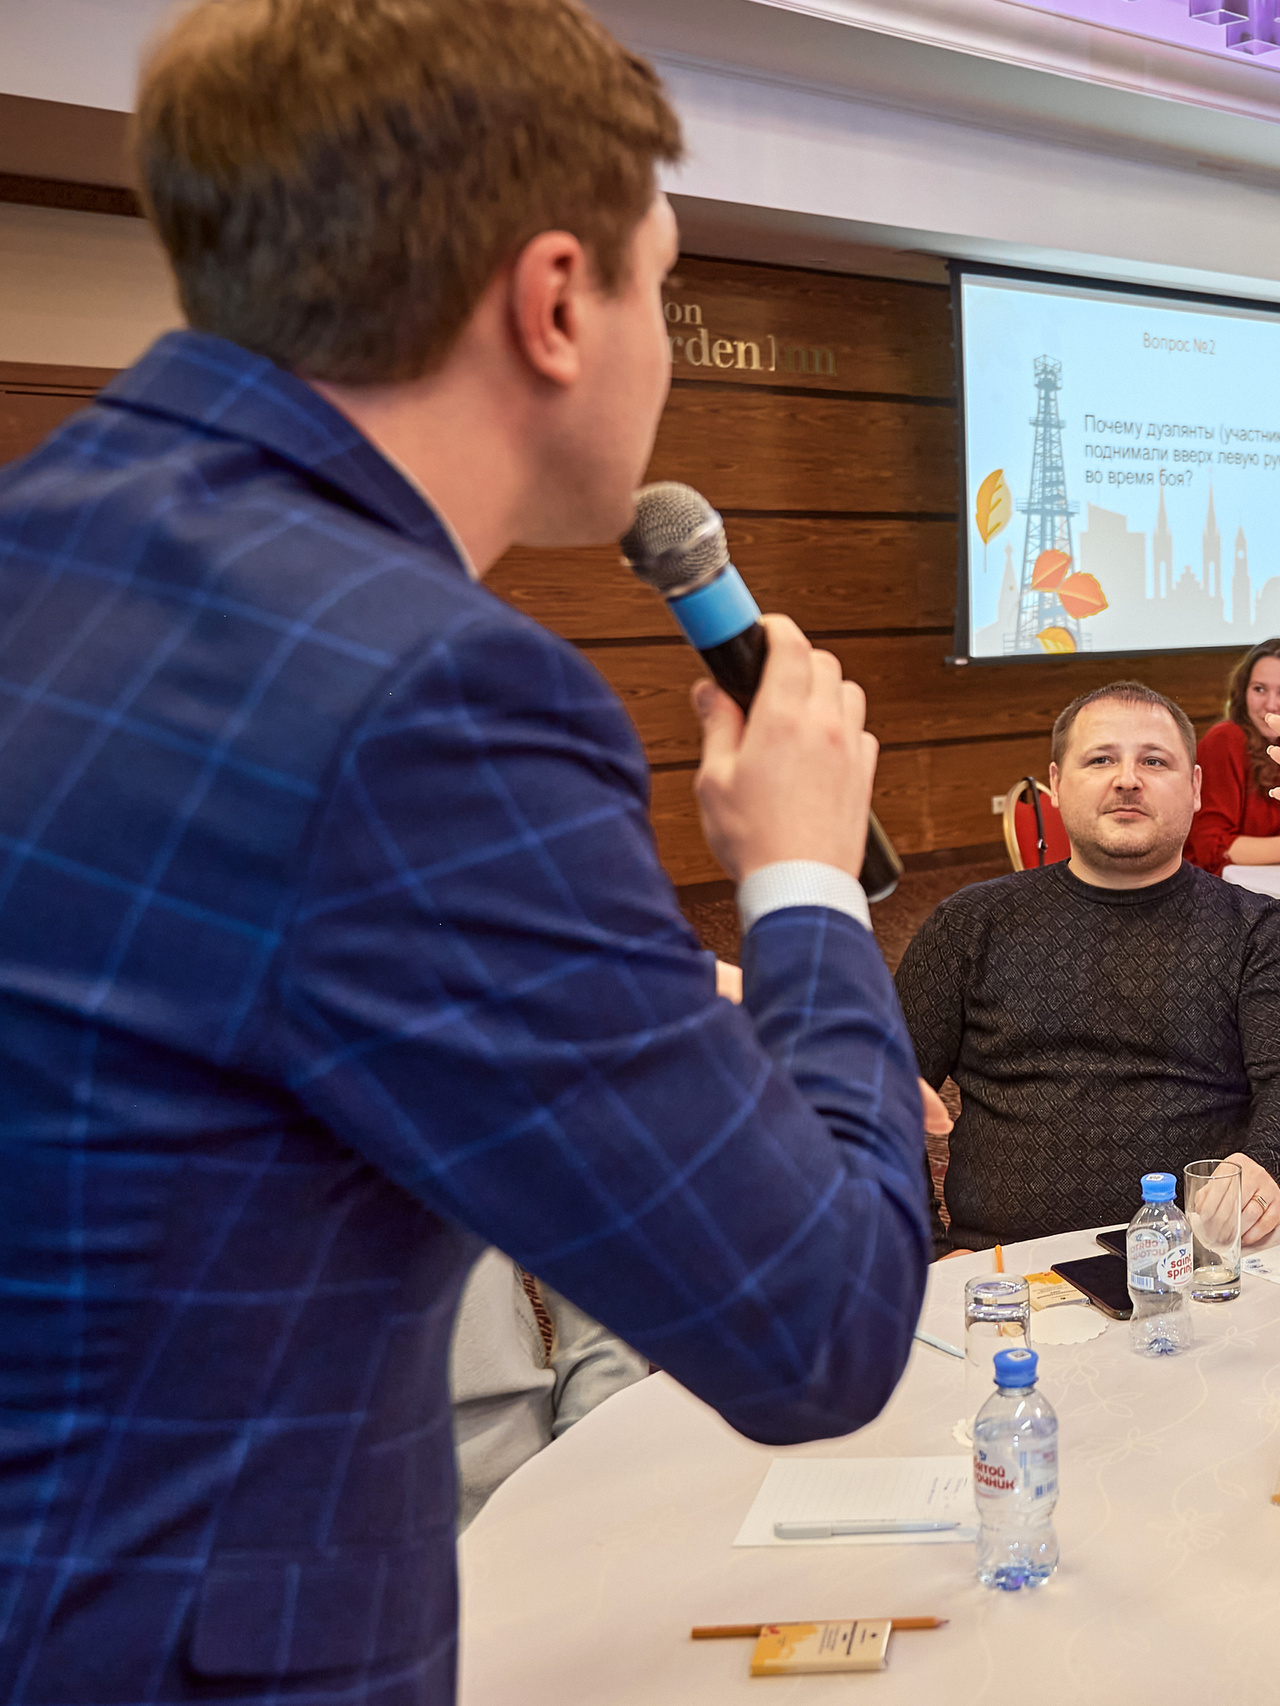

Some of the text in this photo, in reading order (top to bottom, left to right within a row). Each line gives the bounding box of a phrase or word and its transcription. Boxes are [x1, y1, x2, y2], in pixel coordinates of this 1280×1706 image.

[669, 328, 764, 370] rden
[1143, 332, 1191, 353] Вопрос
[1084, 414, 1143, 440] Почему
[1085, 444, 1168, 462] поднимали
[1173, 449, 1213, 467] вверх
[1217, 452, 1259, 469] левую
[1085, 469, 1193, 488] во время боя?
